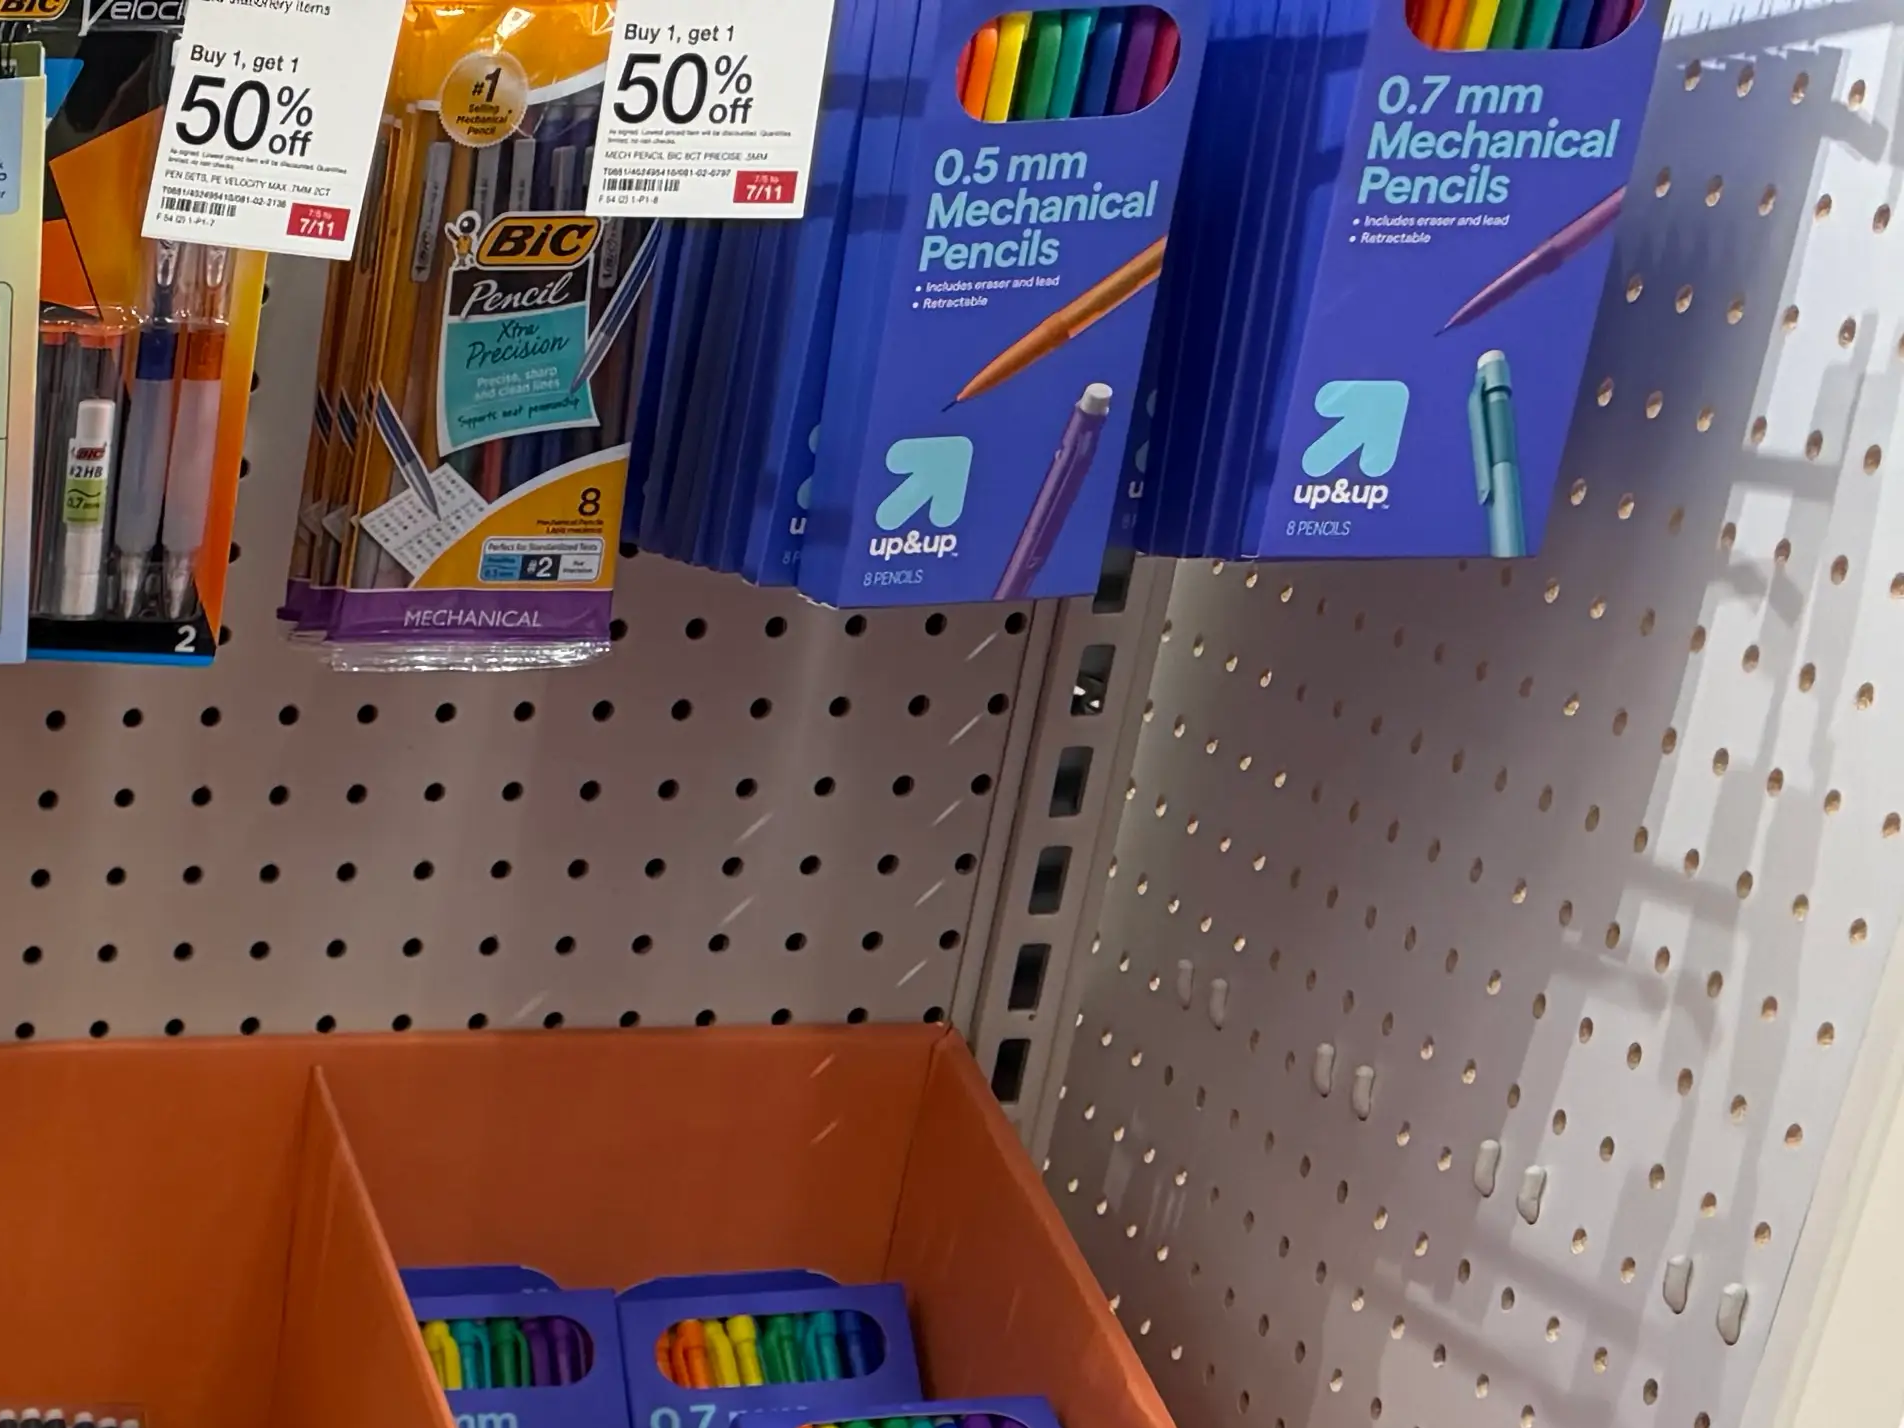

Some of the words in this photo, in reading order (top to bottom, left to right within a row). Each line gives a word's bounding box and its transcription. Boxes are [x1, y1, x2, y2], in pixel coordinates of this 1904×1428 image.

[190, 44, 227, 68] Buy
[252, 55, 284, 73] get
[291, 57, 299, 74] 1
[176, 75, 313, 146] 50%
[1378, 74, 1452, 115] 0.7
[1455, 84, 1544, 114] mm
[269, 130, 312, 157] off
[1366, 117, 1621, 160] Mechanical
[934, 146, 1001, 187] 0.5
[1007, 152, 1087, 180] mm
[1357, 163, 1511, 205] Pencils
[926, 179, 1159, 230] Mechanical
[301, 218, 337, 236] 7/11
[918, 227, 1060, 273] Pencils
[461, 274, 572, 317] Pencil
[925, 279, 973, 293] Includes
[974, 279, 1012, 291] eraser
[1011, 276, 1035, 289] and
[1035, 274, 1061, 287] lead
[922, 295, 989, 309] Retractable
[466, 333, 569, 369] Precision
[577, 488, 601, 517] 8
[1293, 477, 1389, 510] up&up
[869, 529, 959, 562] up&up
[862, 571, 873, 587] 8
[873, 568, 924, 586] PENCILS
[403, 609, 542, 629] MECHANICAL
